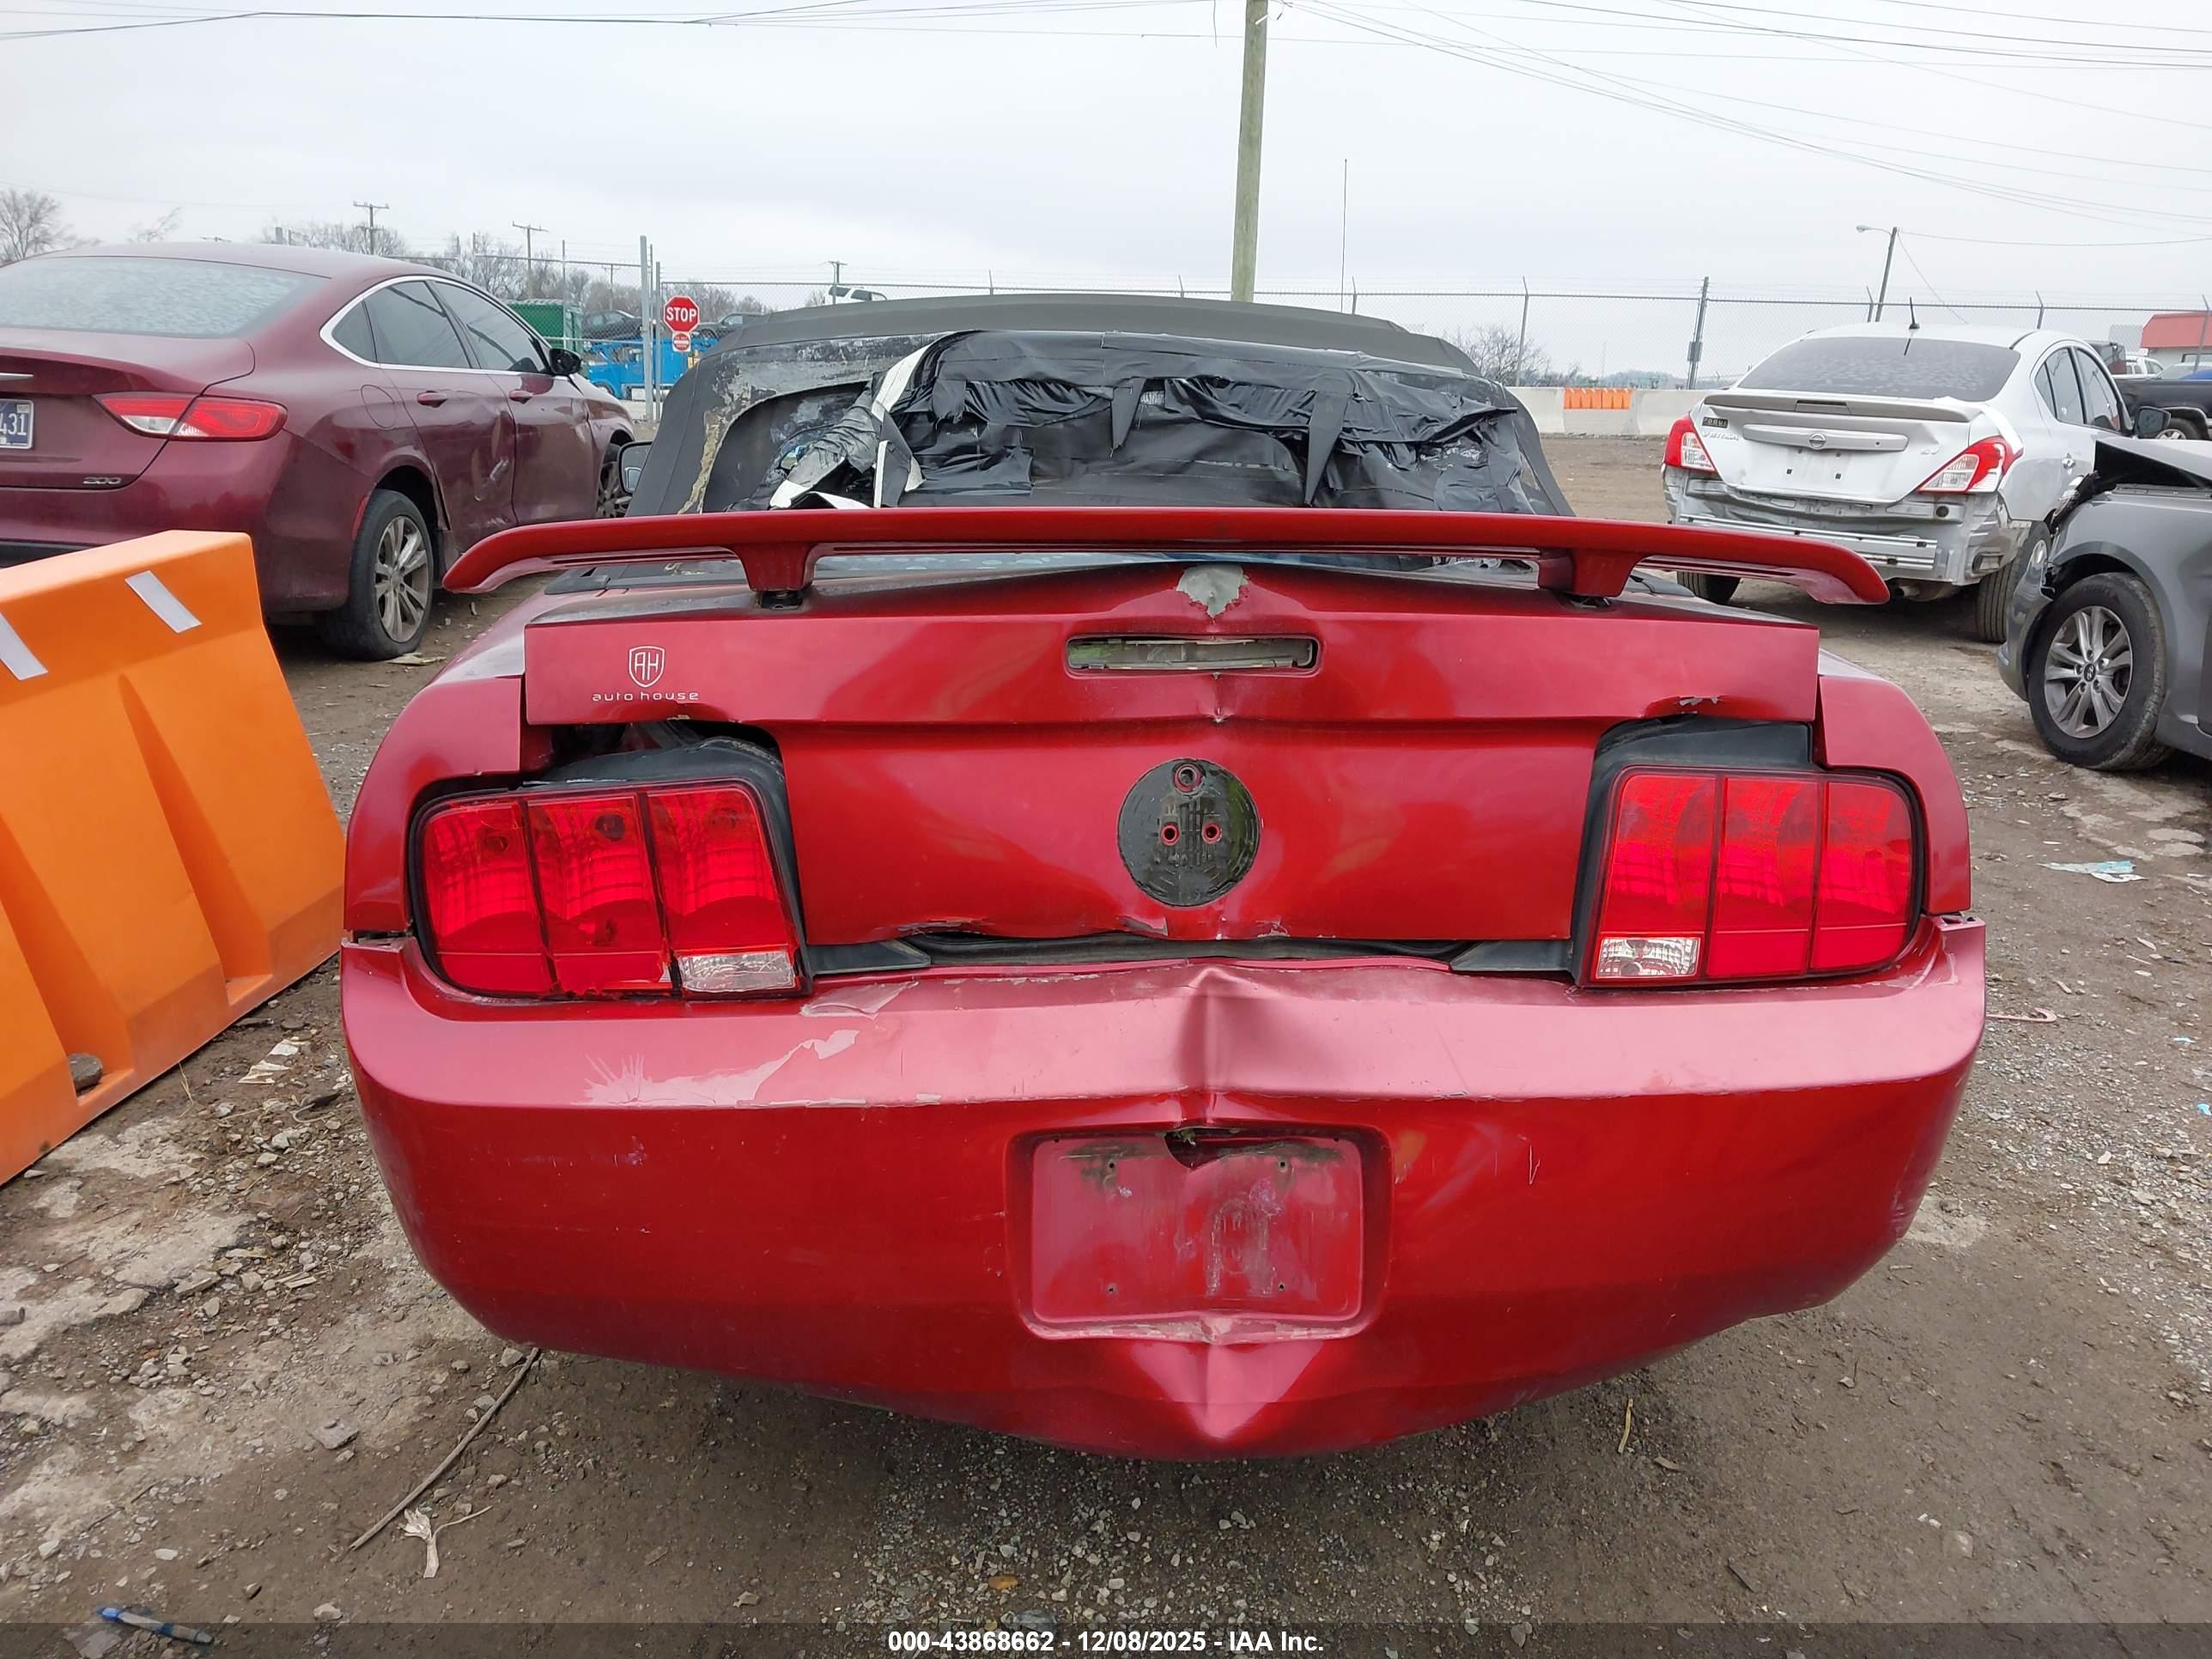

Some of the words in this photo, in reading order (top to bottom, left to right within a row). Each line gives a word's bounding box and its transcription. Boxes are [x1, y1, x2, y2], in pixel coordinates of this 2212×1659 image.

[666, 307, 696, 322] STOP
[634, 651, 659, 681] AH
[592, 691, 634, 702] auto
[640, 690, 700, 702] house
